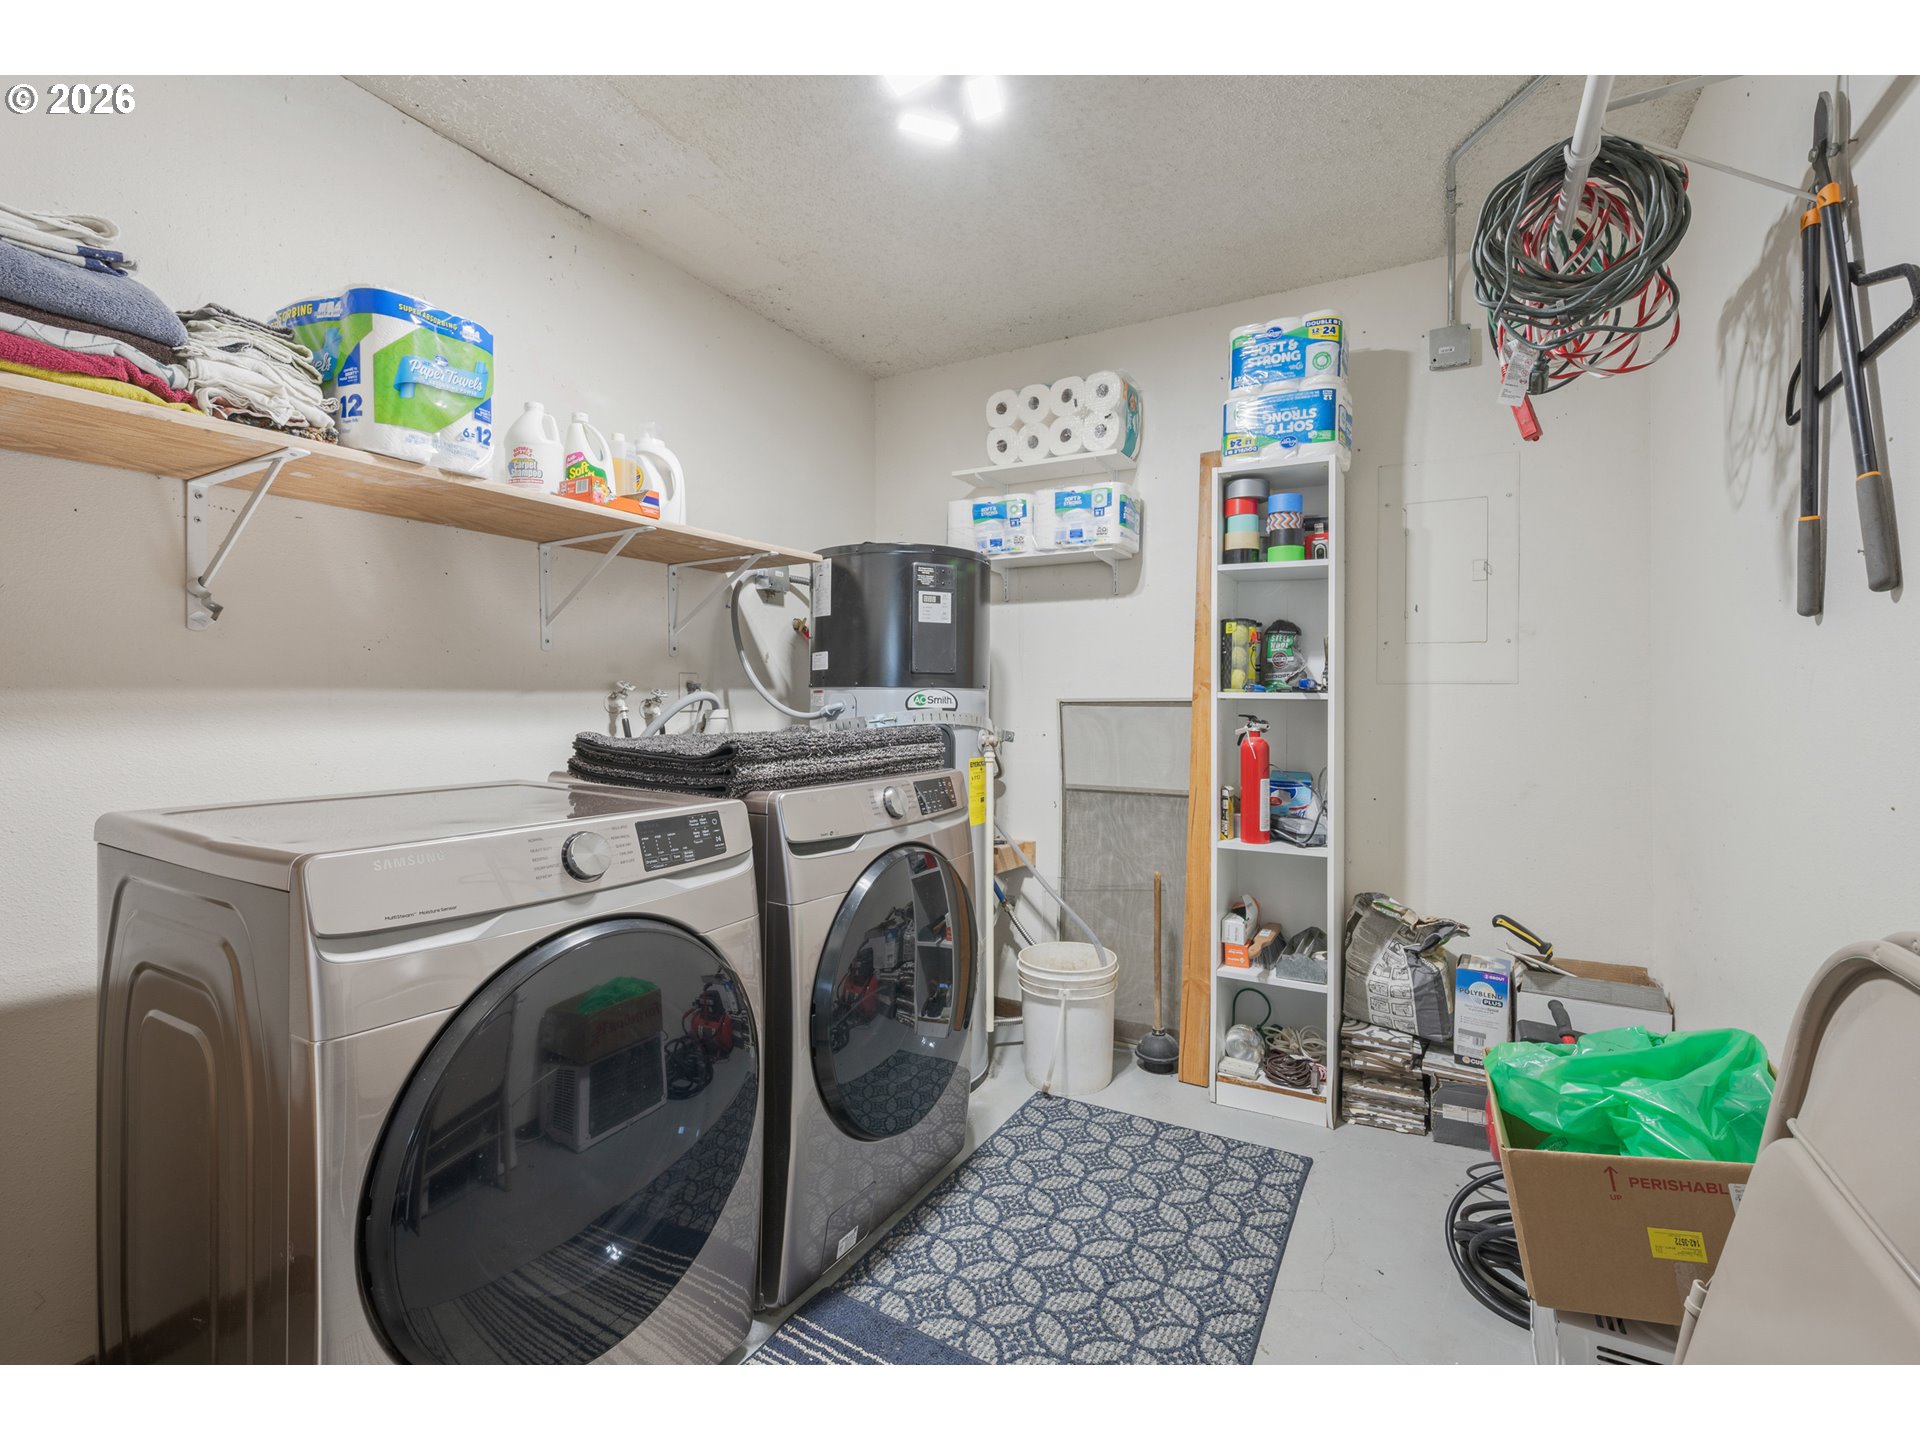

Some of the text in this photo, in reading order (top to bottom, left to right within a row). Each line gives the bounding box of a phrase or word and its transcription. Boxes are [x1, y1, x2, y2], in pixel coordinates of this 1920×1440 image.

[398, 303, 458, 331] SUPER ABSORBING
[1322, 326, 1337, 335] 24
[1250, 340, 1287, 357] SOFT
[1247, 350, 1302, 369] STRONG
[408, 359, 446, 381] Paper
[446, 369, 483, 392] Towels
[339, 393, 363, 419] 12
[1262, 407, 1318, 425] STRONG
[463, 427, 471, 438] 6
[476, 426, 492, 447] 12
[1278, 420, 1314, 435] SOFT
[569, 461, 590, 480] Soft
[927, 695, 952, 705] Smith
[374, 850, 446, 872] SAMSUNG
[1459, 987, 1504, 1001] POLYBLEND
[1628, 1176, 1730, 1196] PERISHABL
[1609, 1193, 1623, 1201] UP
